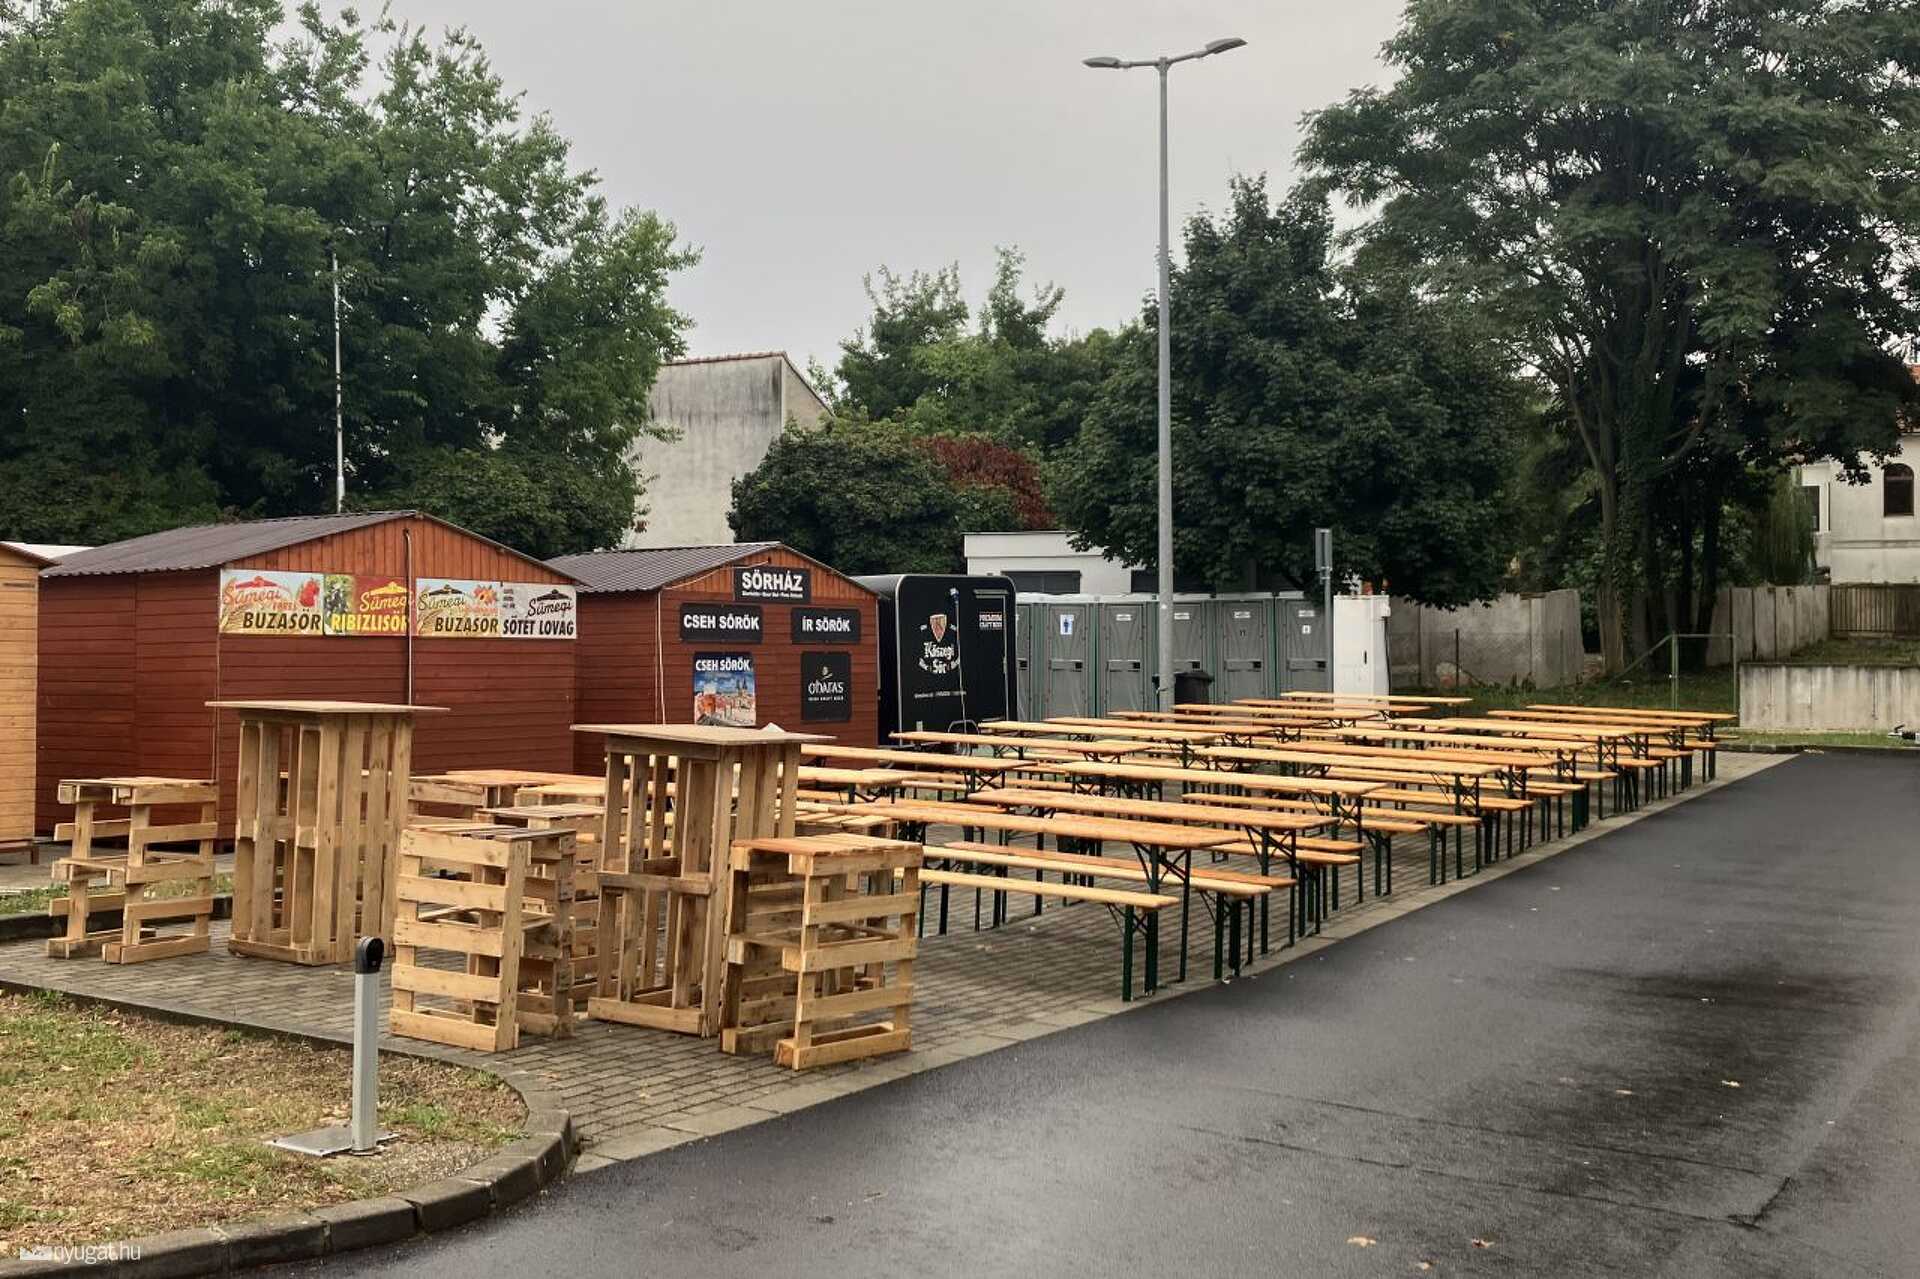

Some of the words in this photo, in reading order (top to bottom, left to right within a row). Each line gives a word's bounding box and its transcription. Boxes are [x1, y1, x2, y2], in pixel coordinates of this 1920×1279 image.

[742, 568, 803, 591] SÖRHÁZ
[527, 597, 574, 618] Sümegi
[539, 619, 574, 636] LOVAG
[683, 614, 717, 629] CSEH
[719, 613, 760, 630] SÖRÖK
[802, 616, 813, 632] ÍR
[816, 617, 851, 633] SÖRÖK
[695, 659, 719, 671] CSEH
[719, 656, 751, 672] SÖRÖK
